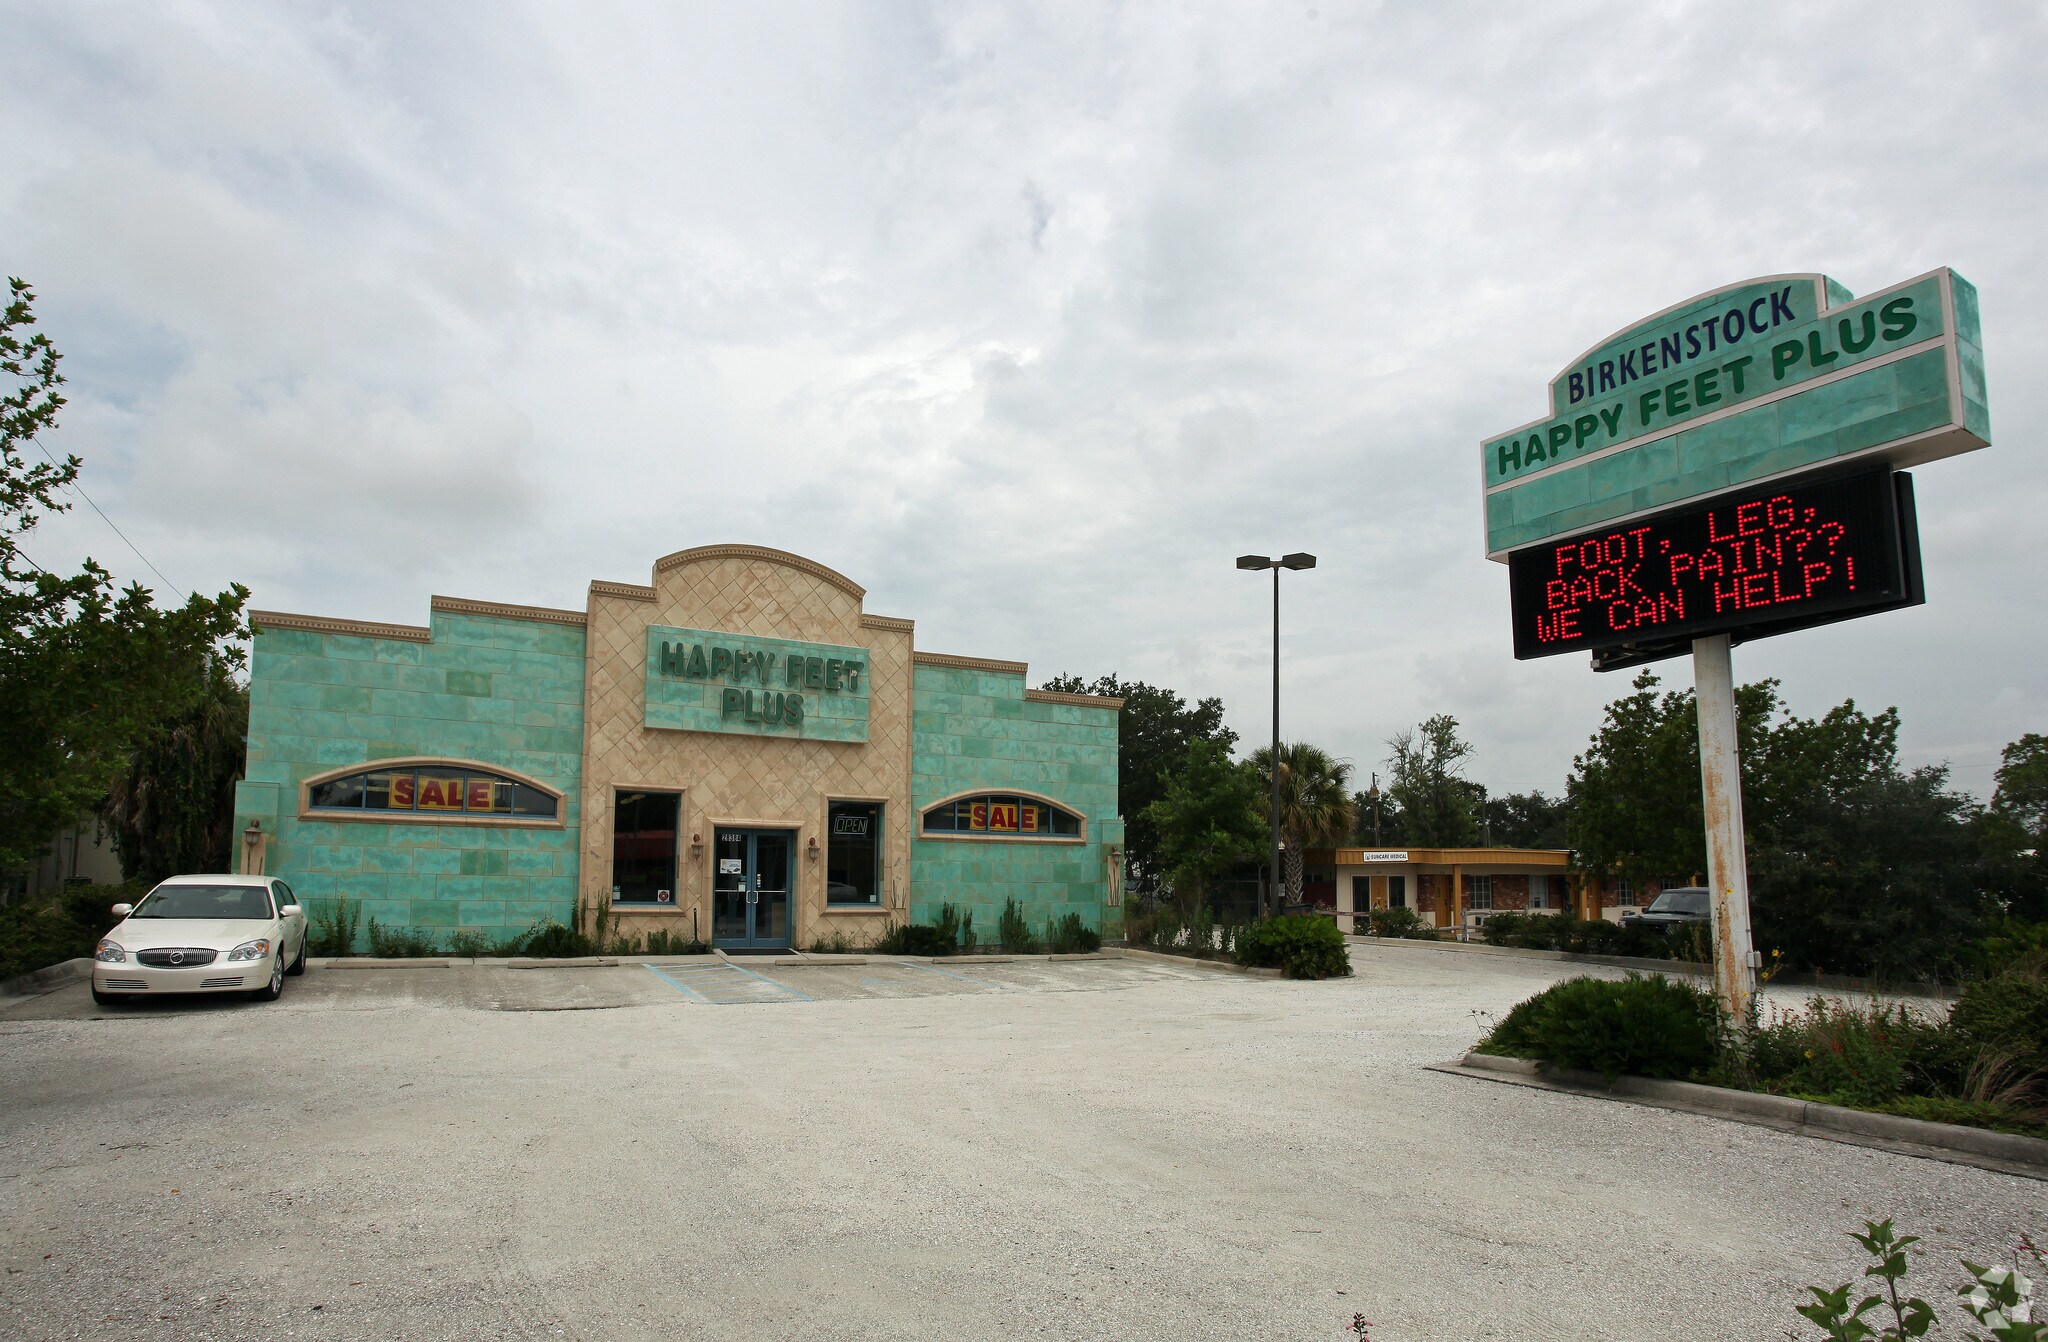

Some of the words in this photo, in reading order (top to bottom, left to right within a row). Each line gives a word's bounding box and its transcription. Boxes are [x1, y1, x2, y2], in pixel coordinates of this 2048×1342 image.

[1568, 286, 1796, 404] BIRKENSTOCK
[1497, 403, 1623, 475] HAPPY
[1640, 355, 1753, 426] FEET
[1771, 297, 1918, 381] PLUS
[1547, 563, 1642, 610] BACK
[1670, 522, 1845, 586] PAIN??
[1556, 527, 1670, 575] FOOT,
[1708, 496, 1815, 543] LEG,
[1537, 608, 1582, 642] WE
[1608, 589, 1684, 630] CAN
[1714, 556, 1855, 613] HELP!
[659, 640, 776, 685] HAPPY
[785, 655, 865, 692] FEET
[720, 688, 805, 726] PLUS
[394, 778, 490, 807] SALE
[973, 805, 1035, 829] SALE
[836, 818, 867, 833] OPEN
